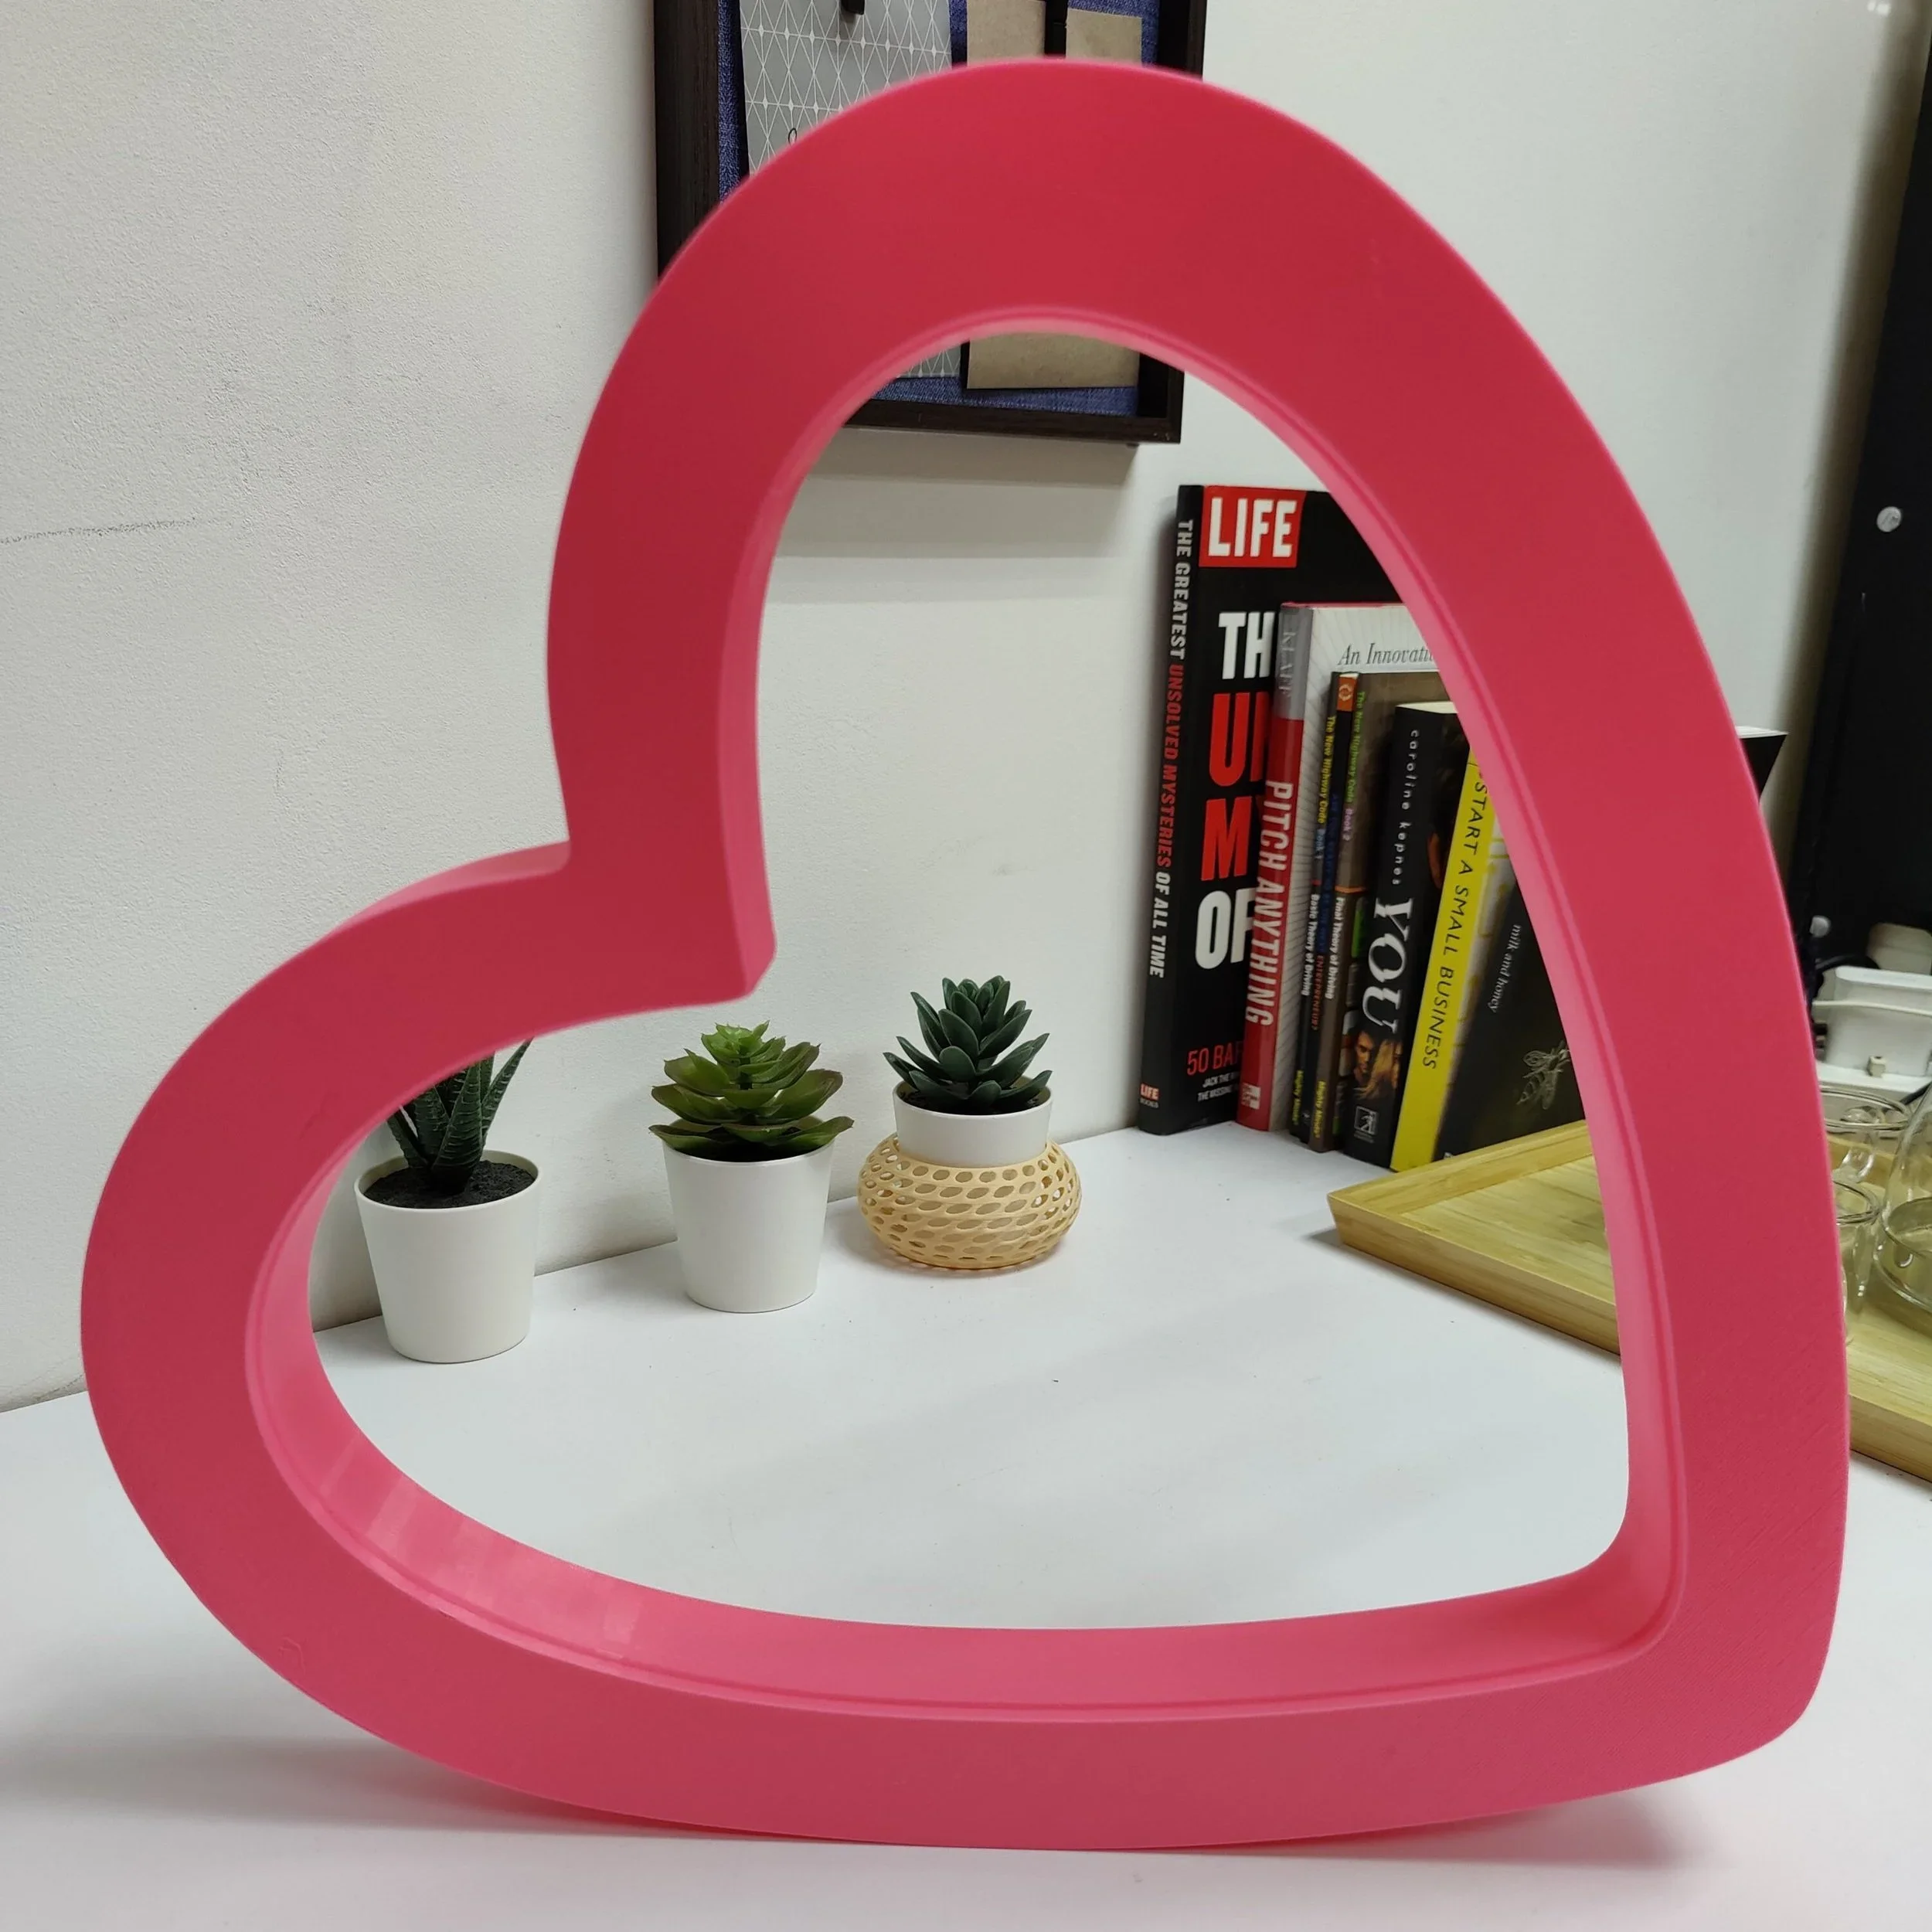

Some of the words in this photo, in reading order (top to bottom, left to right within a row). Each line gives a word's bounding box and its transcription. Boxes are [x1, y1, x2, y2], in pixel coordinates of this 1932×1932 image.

[1176, 519, 1194, 557] THE
[1208, 497, 1298, 557] LIFE
[1170, 563, 1191, 660] GREATEST
[1218, 611, 1275, 679] TH
[1337, 643, 1361, 665] An
[1366, 642, 1434, 665] Innovati
[1164, 664, 1184, 760] UNSOLVED
[1357, 691, 1366, 709] The
[1325, 716, 1337, 733] The
[1354, 711, 1363, 733] New
[1324, 735, 1335, 757] New
[1348, 735, 1361, 777] Highway
[1319, 758, 1332, 799] Highway
[1401, 730, 1419, 810] caroline
[1345, 779, 1356, 803] Code
[1157, 764, 1177, 868] MYSTERIES
[1259, 780, 1293, 871] PITCH
[1317, 800, 1328, 824] Code
[1343, 808, 1353, 832] Book
[1464, 781, 1488, 856] START
[1200, 795, 1253, 882] M
[1315, 828, 1326, 852] Book
[1392, 821, 1412, 885] kepnes
[1458, 859, 1473, 875] A
[1155, 872, 1171, 895] OF
[1152, 897, 1168, 929] ALL
[1309, 893, 1321, 919] Basic
[1335, 896, 1345, 921] Final
[1443, 885, 1468, 956] SMALL
[1196, 887, 1256, 969] OF
[1305, 921, 1318, 951] Theory
[1329, 922, 1343, 954] Theory
[1506, 924, 1522, 951] milk
[1149, 934, 1166, 978] TIME
[1245, 876, 1285, 1026] ANYTHING
[1305, 952, 1314, 963] of
[1329, 954, 1339, 965] of
[1362, 897, 1413, 1034] YOU
[1499, 953, 1512, 978] and
[1301, 964, 1314, 996] Driving
[1325, 966, 1338, 999] Driving
[1488, 978, 1509, 1013] honey
[1422, 966, 1454, 1070] BUSINESS
[1186, 1047, 1209, 1076] 50
[1140, 1083, 1159, 1100] LIFE
